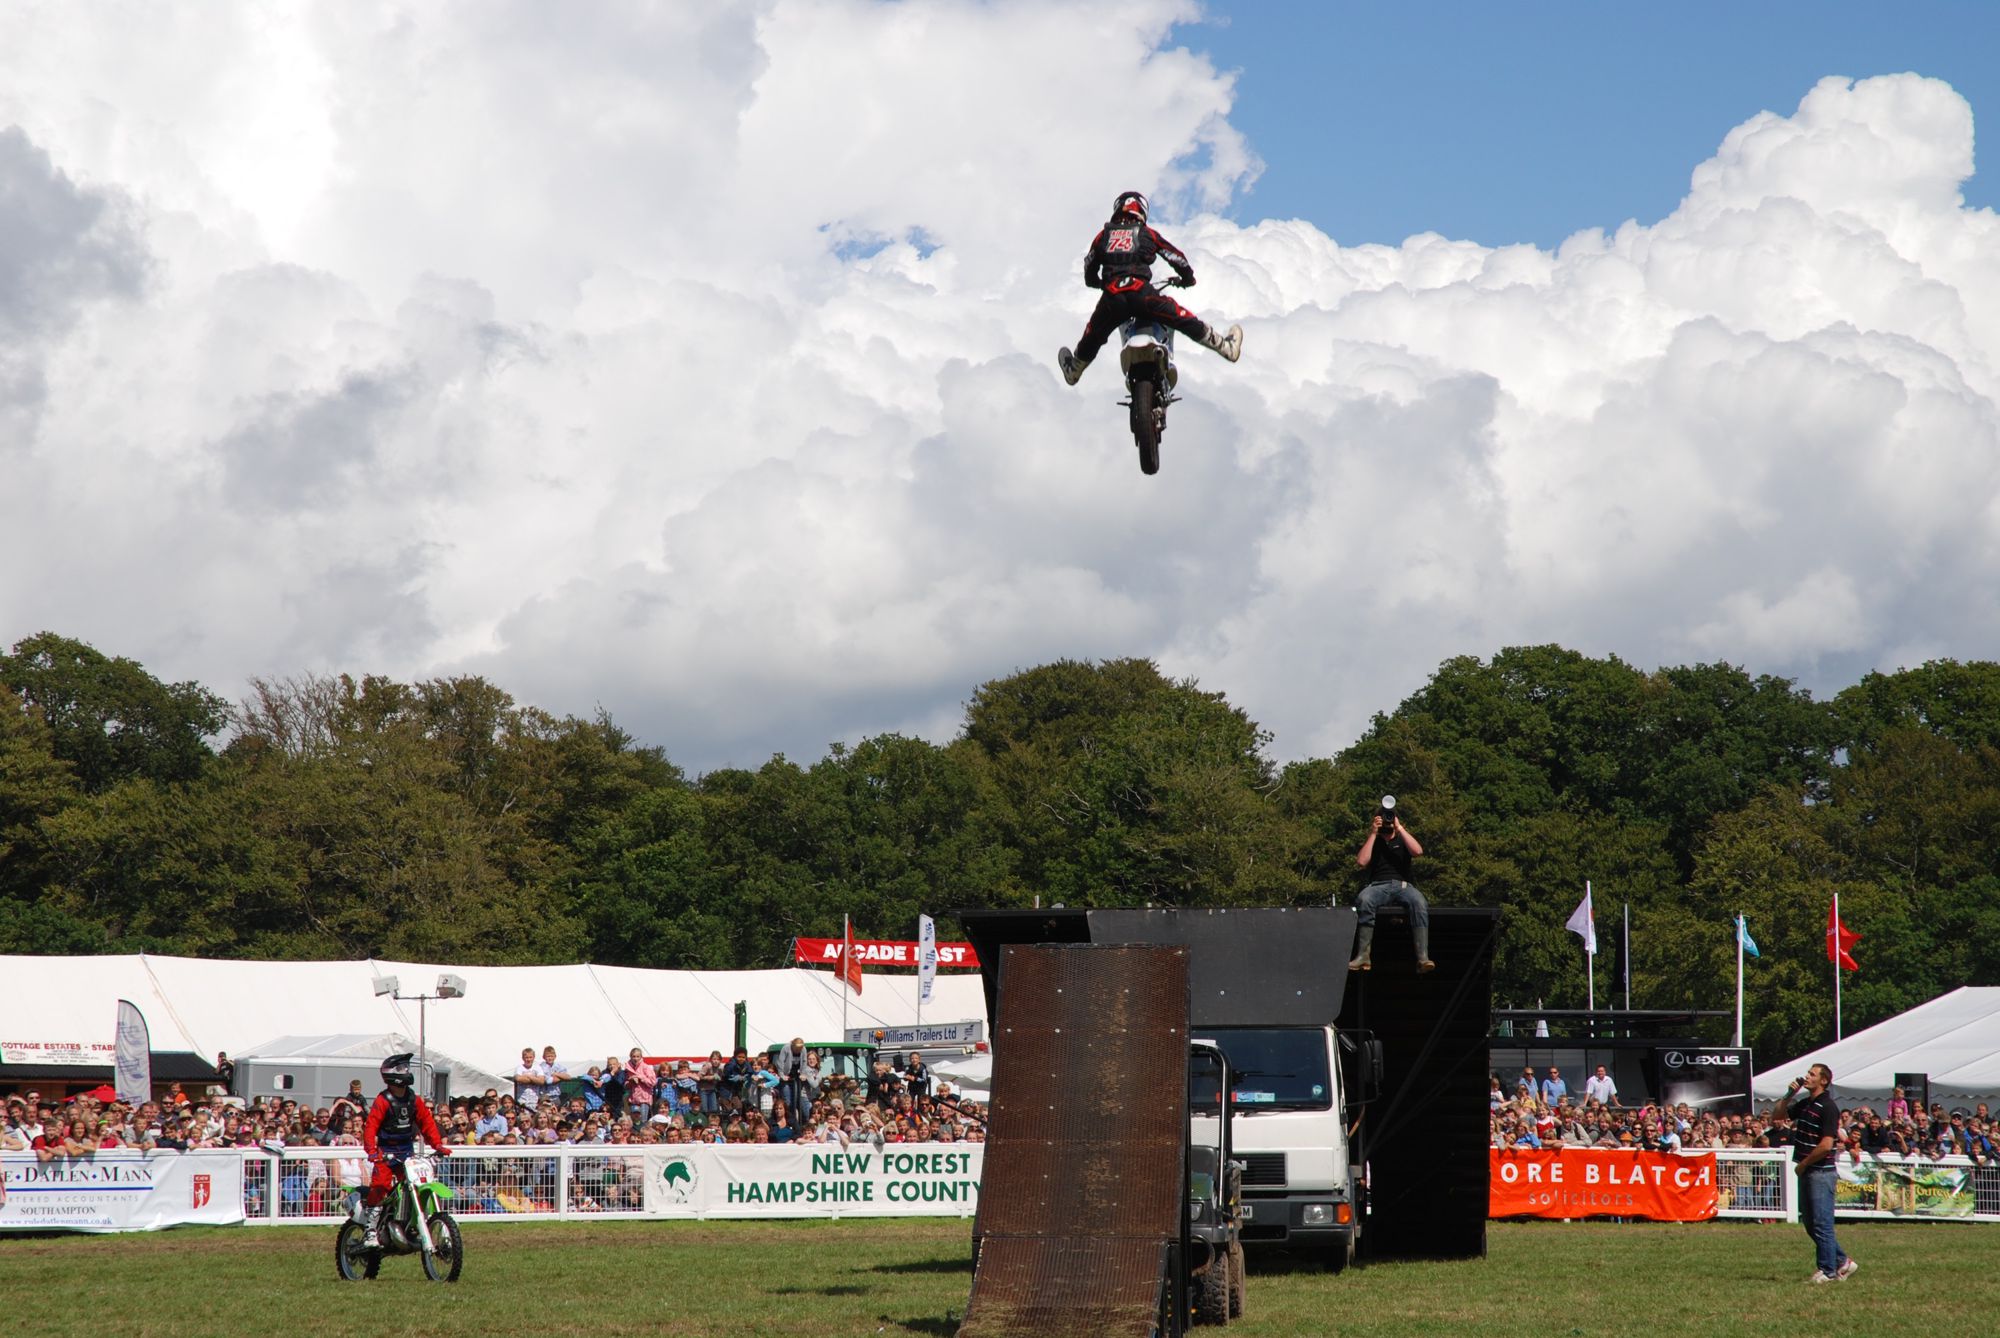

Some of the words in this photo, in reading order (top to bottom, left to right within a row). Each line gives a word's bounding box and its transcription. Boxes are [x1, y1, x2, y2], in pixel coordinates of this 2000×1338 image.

[1106, 236, 1133, 252] 74
[884, 1029, 914, 1043] Williams
[916, 1027, 943, 1041] Trailers
[944, 1026, 957, 1039] Ltd
[1, 1042, 40, 1050] COTTAGE
[44, 1043, 81, 1051] ESTATES
[1686, 1055, 1740, 1065] LEXUS
[812, 1154, 871, 1174] NEW
[883, 1153, 970, 1174] FOREST
[25, 1167, 89, 1182] DATLEN
[101, 1166, 152, 1181] MANN
[1501, 1163, 1563, 1183] ORE
[1585, 1164, 1710, 1187] BLATCH
[8, 1195, 49, 1203] RTERED
[57, 1194, 139, 1203] ACCOUNTANTS
[728, 1181, 873, 1203] HAMPSHIRE
[1528, 1190, 1633, 1206] solicitors
[20, 1206, 96, 1216] SOUTHAMPTON
